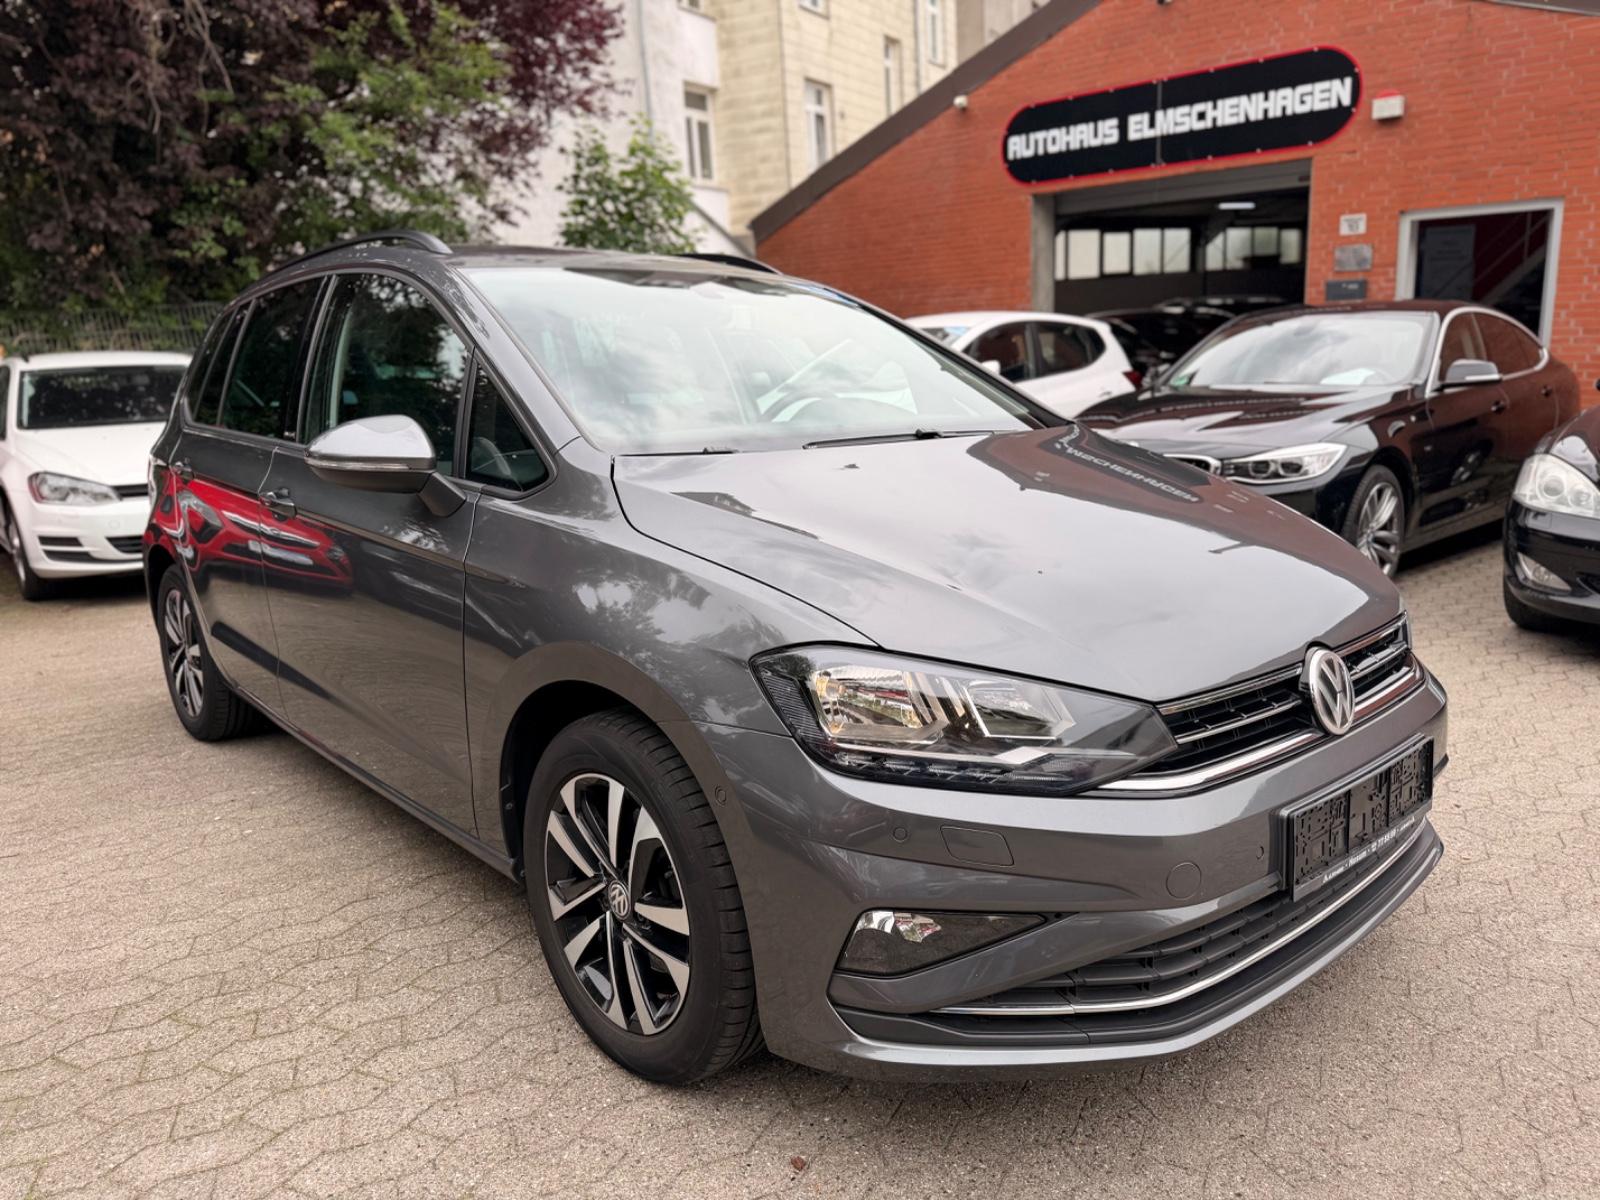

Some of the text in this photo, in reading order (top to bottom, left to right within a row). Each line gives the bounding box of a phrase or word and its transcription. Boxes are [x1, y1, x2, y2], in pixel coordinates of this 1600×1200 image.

[1006, 76, 1353, 161] AUTOHAUS ELMSCHENHAGEN
[1309, 648, 1355, 735] VW
